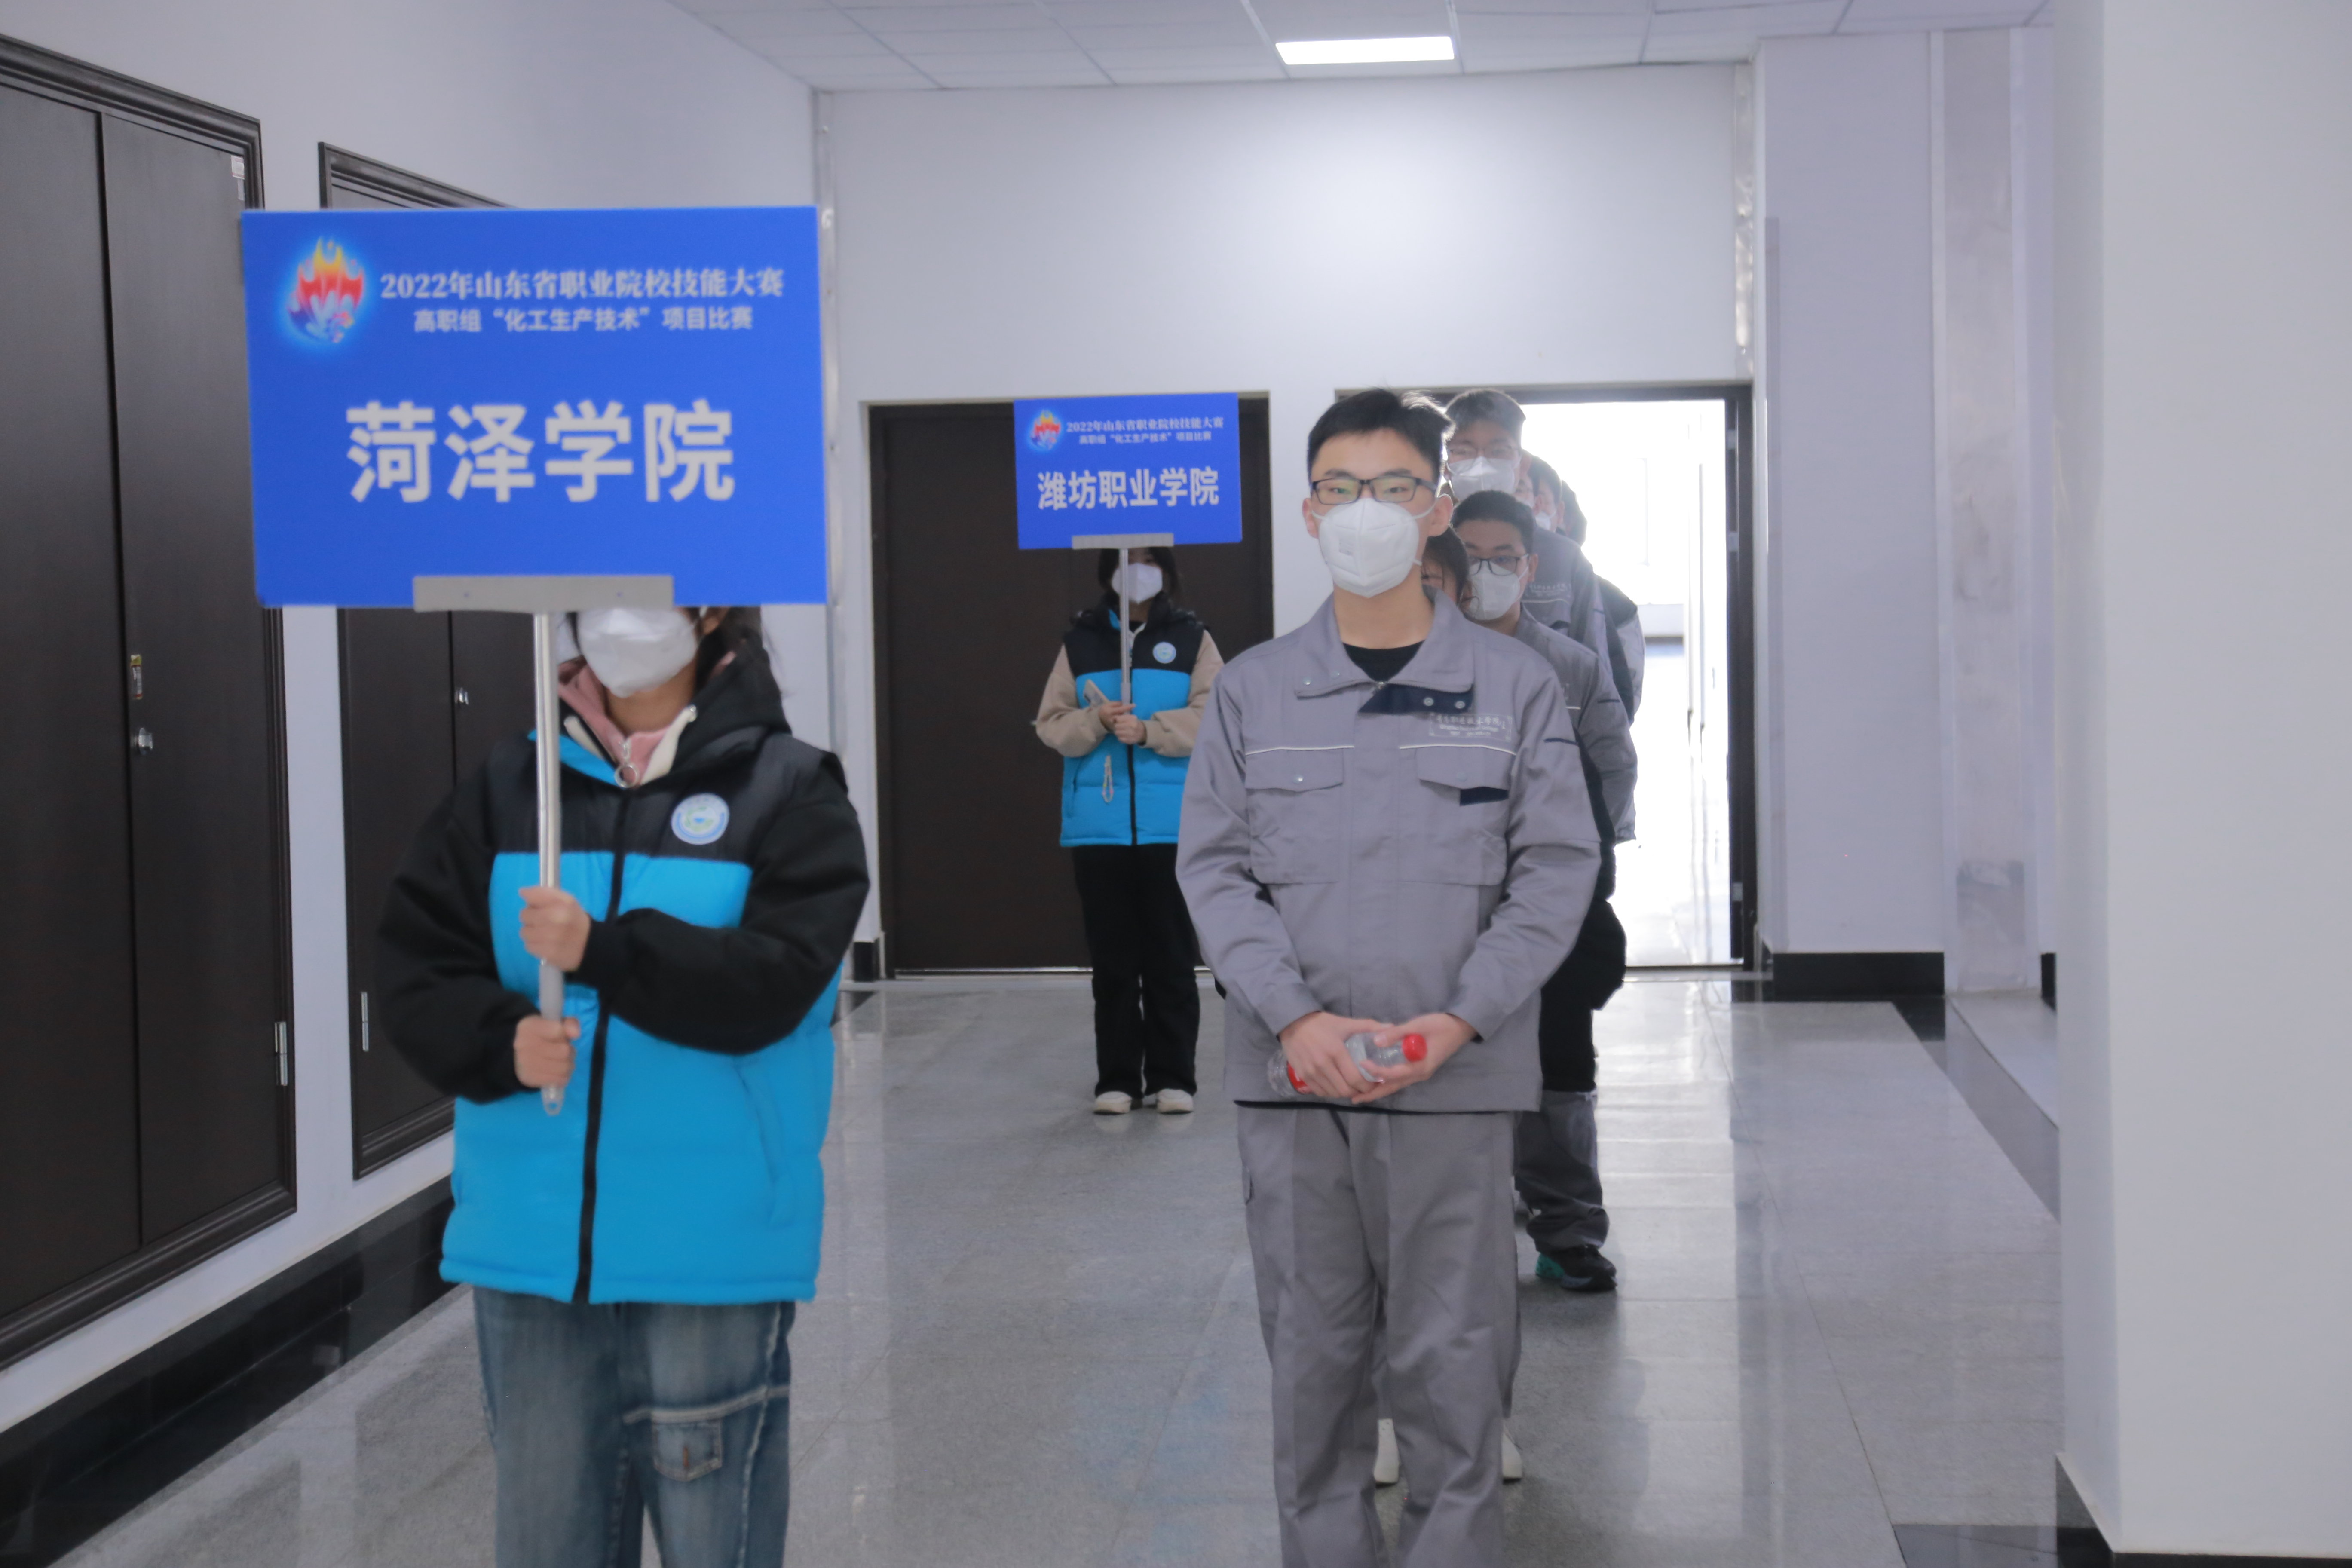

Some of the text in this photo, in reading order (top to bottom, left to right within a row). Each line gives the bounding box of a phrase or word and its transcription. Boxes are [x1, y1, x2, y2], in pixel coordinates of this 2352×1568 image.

[381, 268, 784, 299] 2022年山东省职业院校技能大赛
[1067, 417, 1224, 432] 2022年山东省职业院校技能大赛
[346, 398, 735, 503] 菏泽学院
[1038, 466, 1220, 510] 潍坊职业学院
